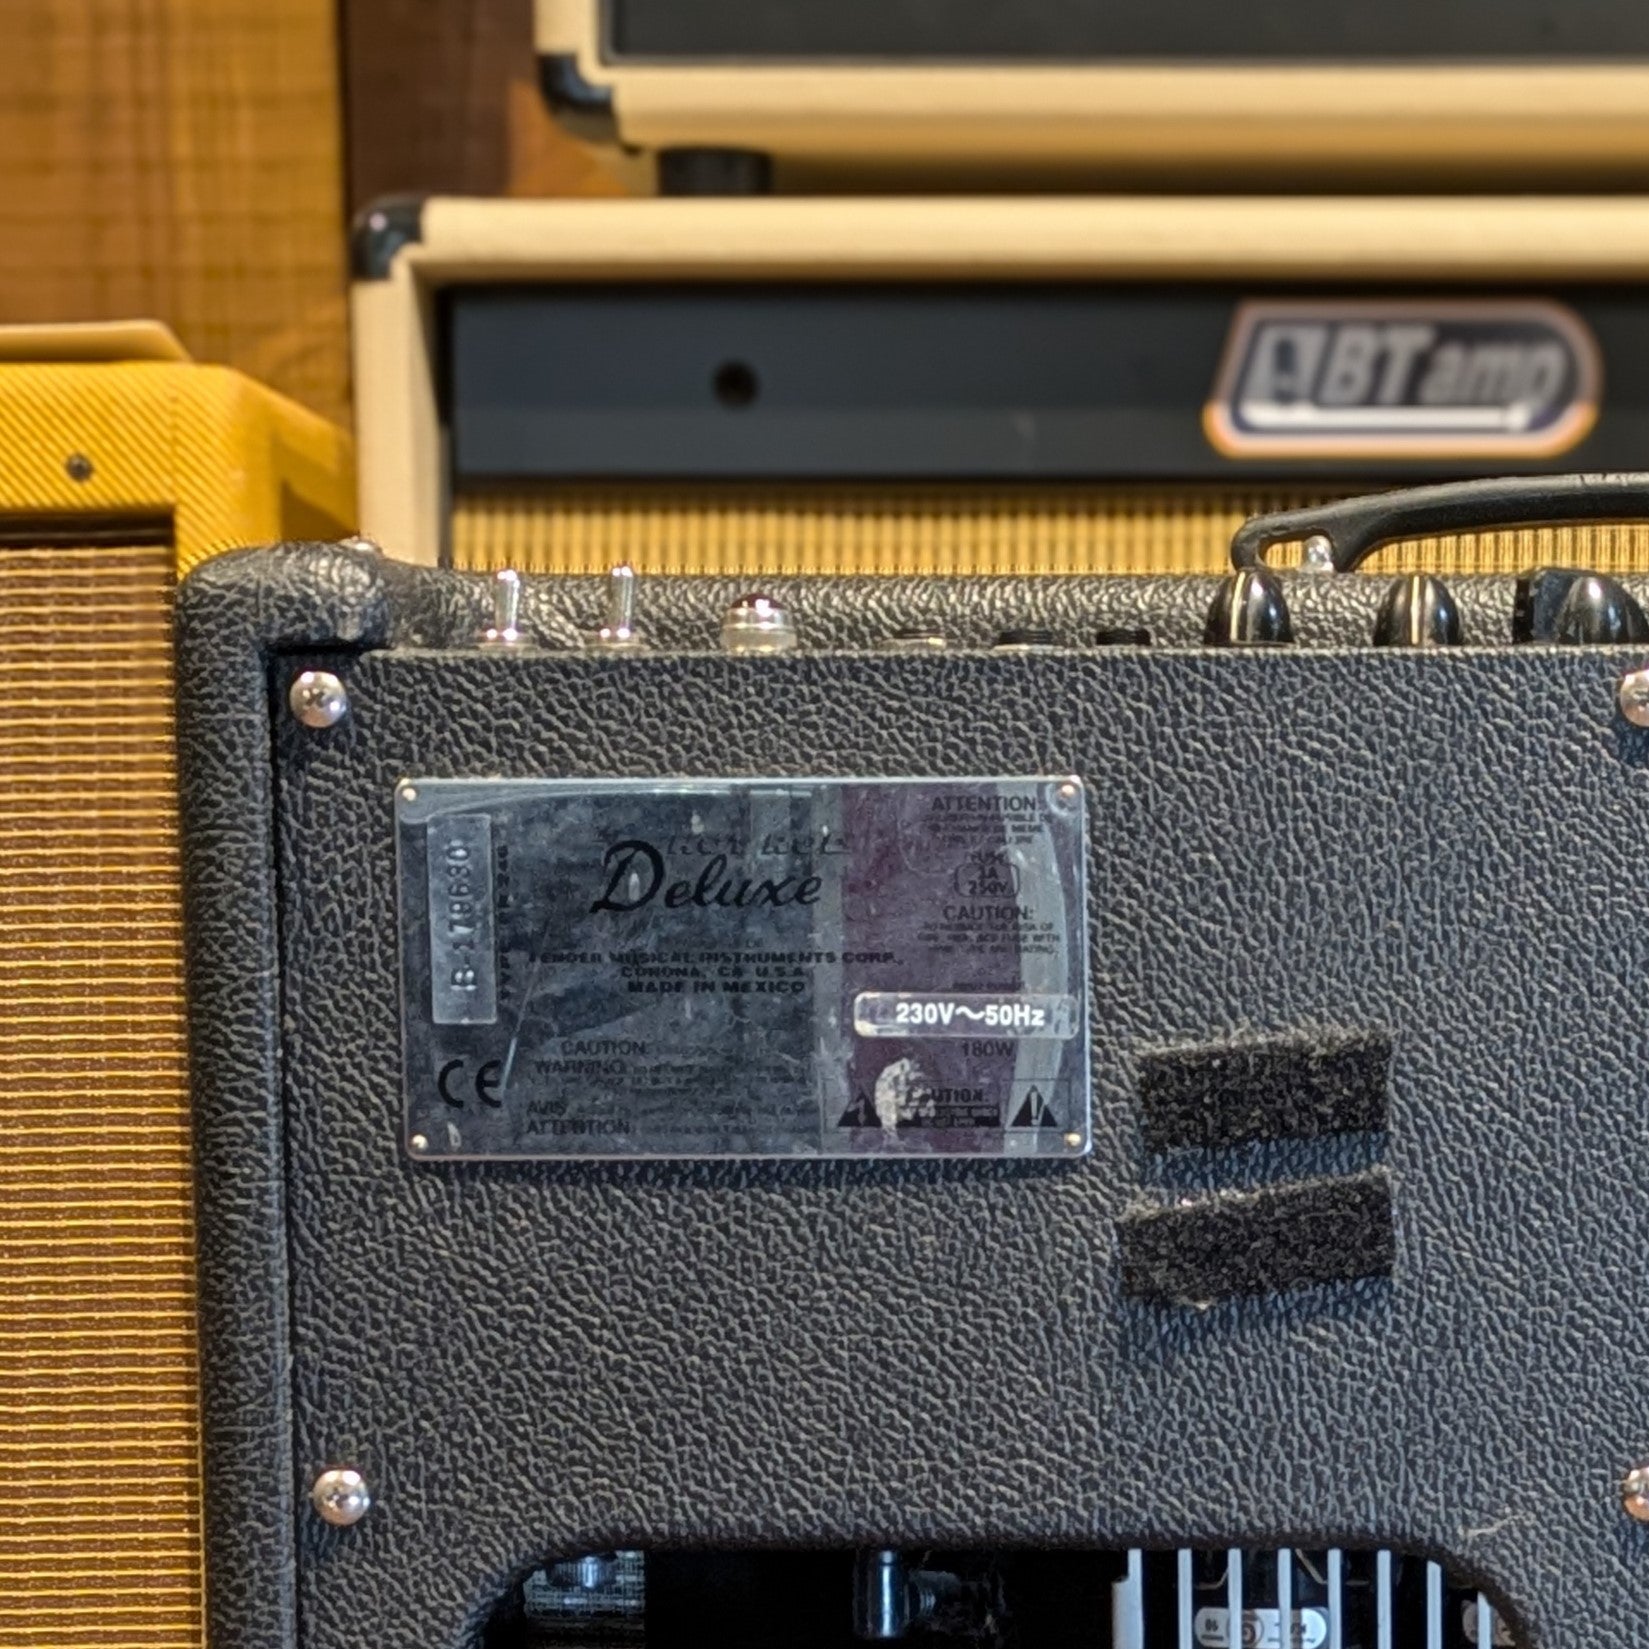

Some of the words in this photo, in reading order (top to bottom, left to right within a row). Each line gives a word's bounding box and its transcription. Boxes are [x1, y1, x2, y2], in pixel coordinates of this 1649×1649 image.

[589, 839, 823, 914] Deluxe
[699, 951, 837, 964] INSTRUMENTS
[627, 980, 684, 993] MADE
[693, 980, 716, 993] IN
[722, 980, 806, 993] MEXICO
